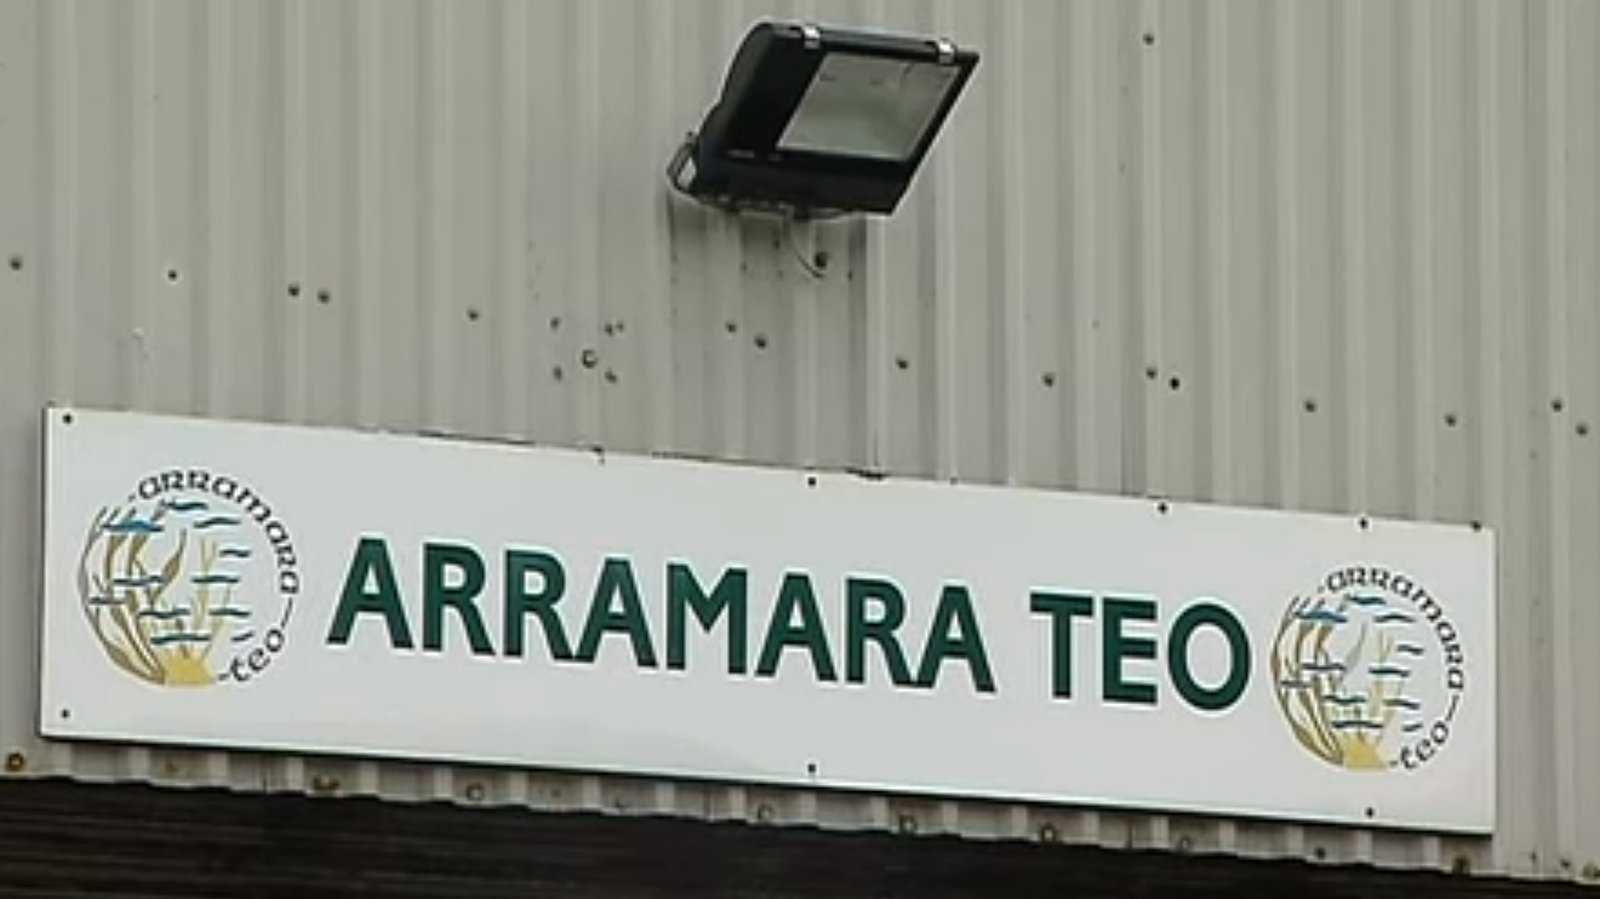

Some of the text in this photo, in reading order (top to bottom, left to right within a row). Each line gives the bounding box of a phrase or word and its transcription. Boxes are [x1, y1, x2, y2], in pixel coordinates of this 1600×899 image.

[230, 628, 285, 682] teo
[327, 537, 1252, 711] ARRAMARA TEO
